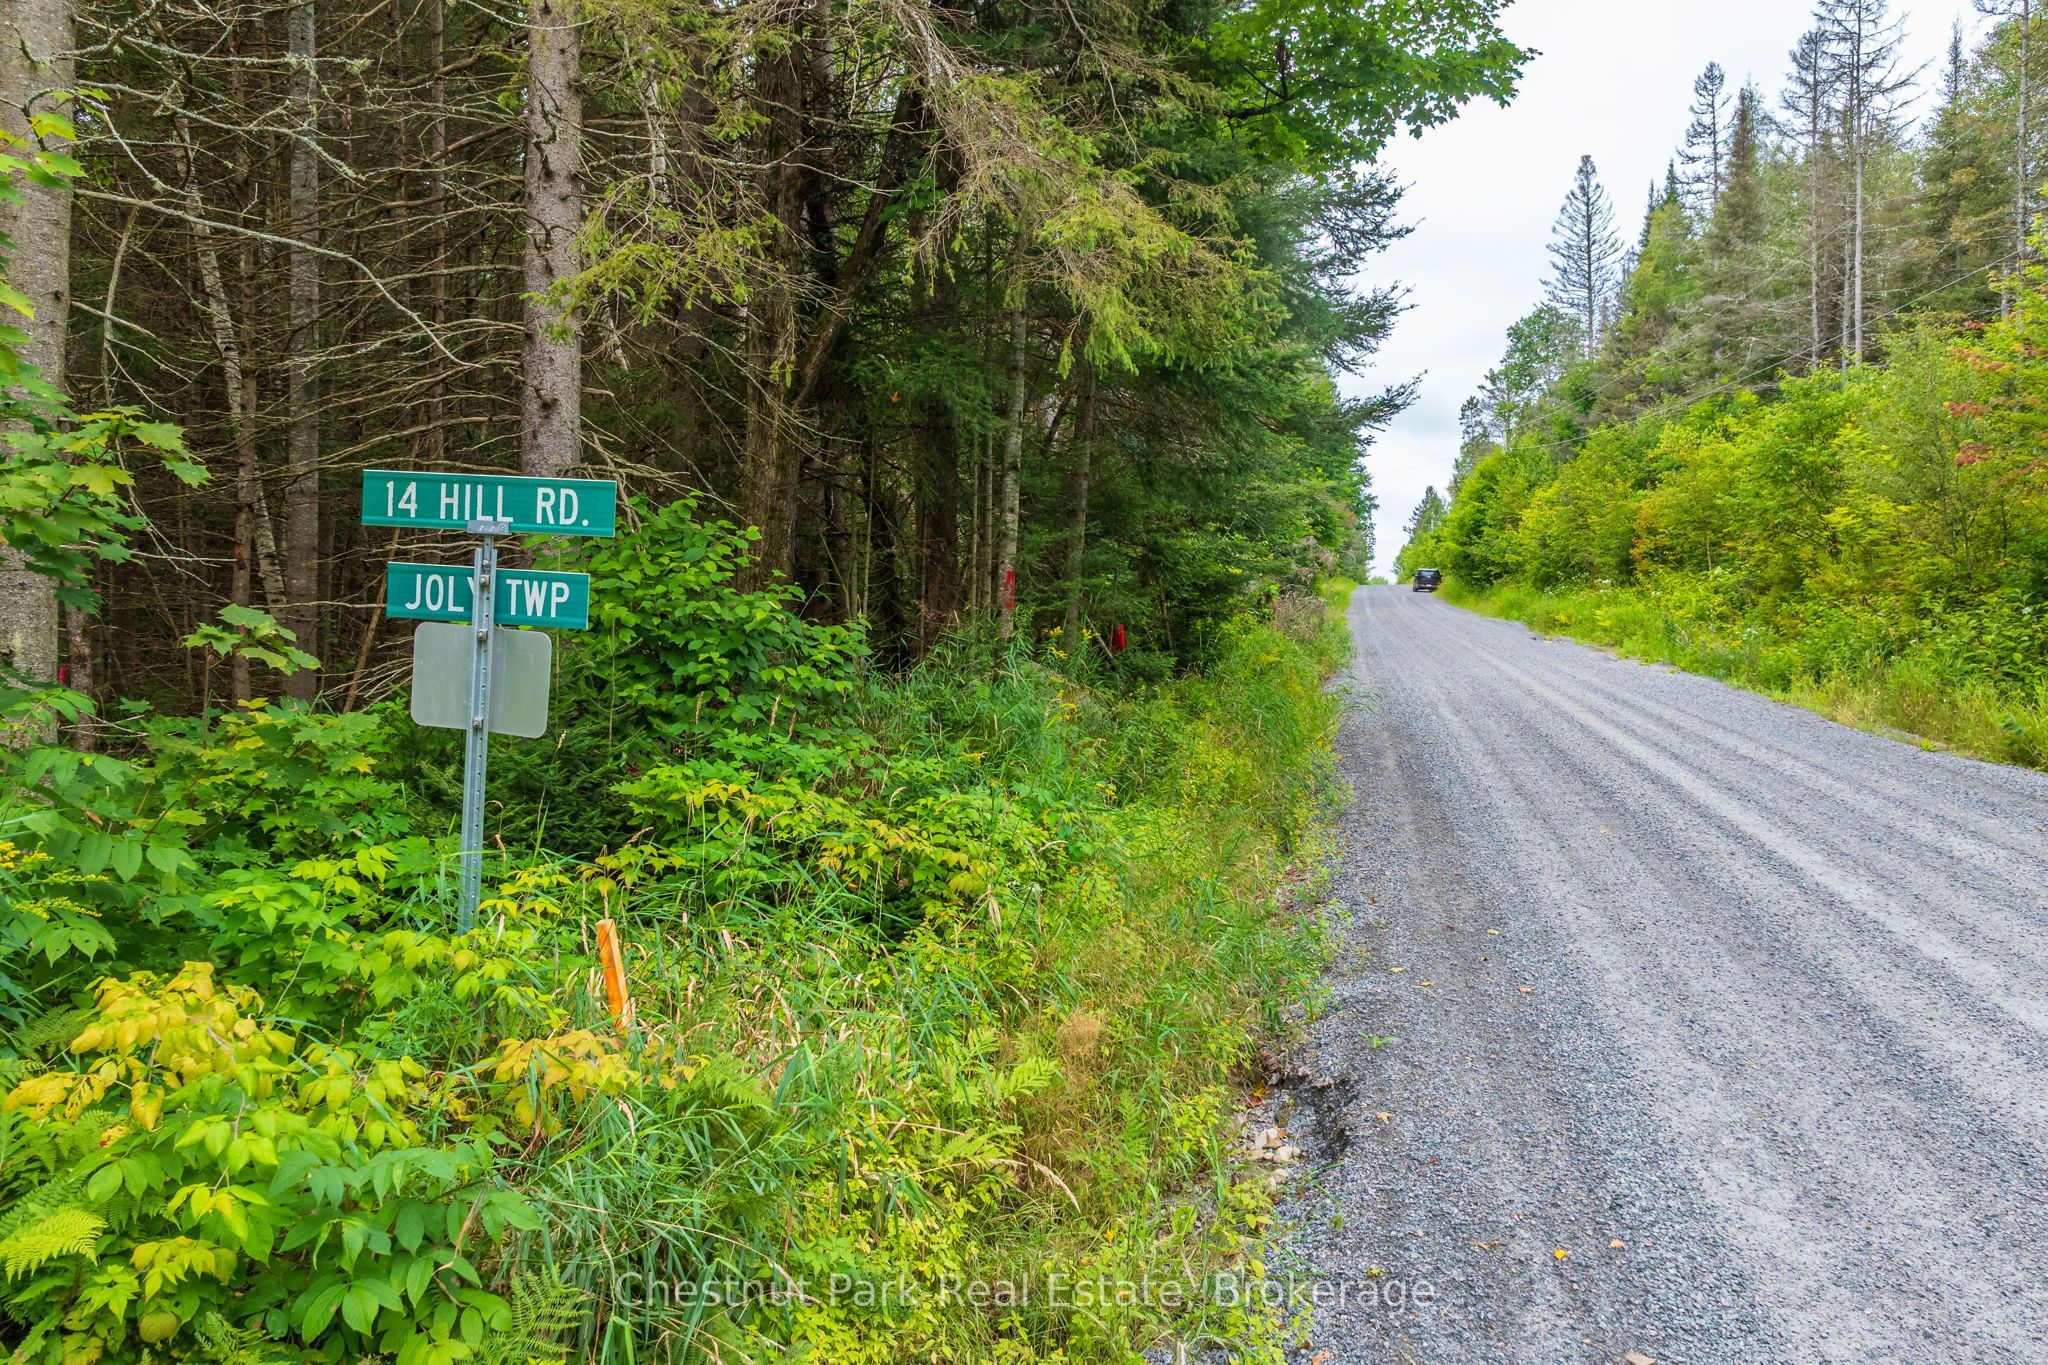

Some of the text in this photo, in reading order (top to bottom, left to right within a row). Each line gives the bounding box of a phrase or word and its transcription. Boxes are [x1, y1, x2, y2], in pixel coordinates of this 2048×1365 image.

[386, 480, 589, 527] 14 HILL RD.
[505, 578, 570, 618] TWP
